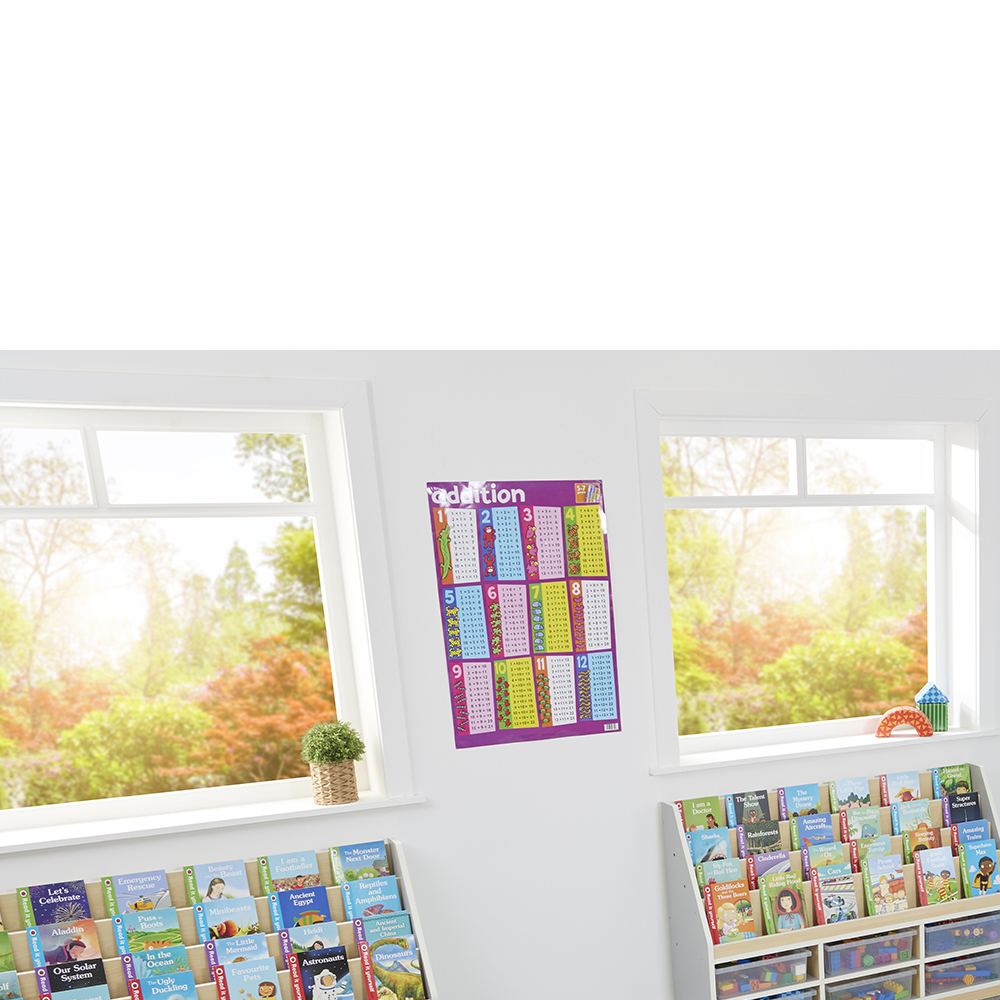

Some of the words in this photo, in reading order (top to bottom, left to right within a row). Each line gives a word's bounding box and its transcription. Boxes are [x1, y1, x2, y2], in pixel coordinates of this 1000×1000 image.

[437, 510, 443, 523] 1
[481, 510, 491, 524] 2
[523, 508, 533, 521] 3
[566, 508, 575, 521] 4
[444, 590, 455, 604] 5
[488, 587, 497, 600] 6
[531, 586, 540, 598] 7
[572, 582, 581, 596] 8
[452, 664, 462, 678] 9
[494, 662, 506, 675] 10
[536, 658, 545, 670] 11
[577, 656, 588, 668] 12
[352, 847, 380, 856] Monster
[208, 864, 233, 873] Beauty
[275, 863, 313, 872] Footballer
[220, 870, 242, 878] Beast
[118, 875, 161, 885] Emergency
[359, 880, 388, 890] Reptiles
[48, 886, 69, 896] Let's
[127, 883, 155, 892] Rescue
[39, 895, 81, 905] Celebrate
[290, 892, 315, 900] Ancient
[355, 894, 397, 904] Amphibians
[293, 898, 314, 906] Egypt
[209, 905, 251, 916] Minibeasts
[140, 921, 163, 929] Boots
[381, 923, 406, 932] Imperial
[51, 926, 84, 936] Aladdin
[303, 927, 323, 935] Heidi
[236, 938, 255, 946] Little
[226, 944, 258, 954] Mermaid
[302, 954, 345, 967] Astronauts
[375, 950, 413, 961] Dinosaurs
[147, 959, 174, 968] Ocean
[53, 967, 71, 975] Our
[73, 963, 97, 972] Solar
[231, 964, 270, 976] Favourite
[60, 972, 93, 982] System
[157, 977, 175, 986] Ugly
[152, 984, 188, 995] Duckling
